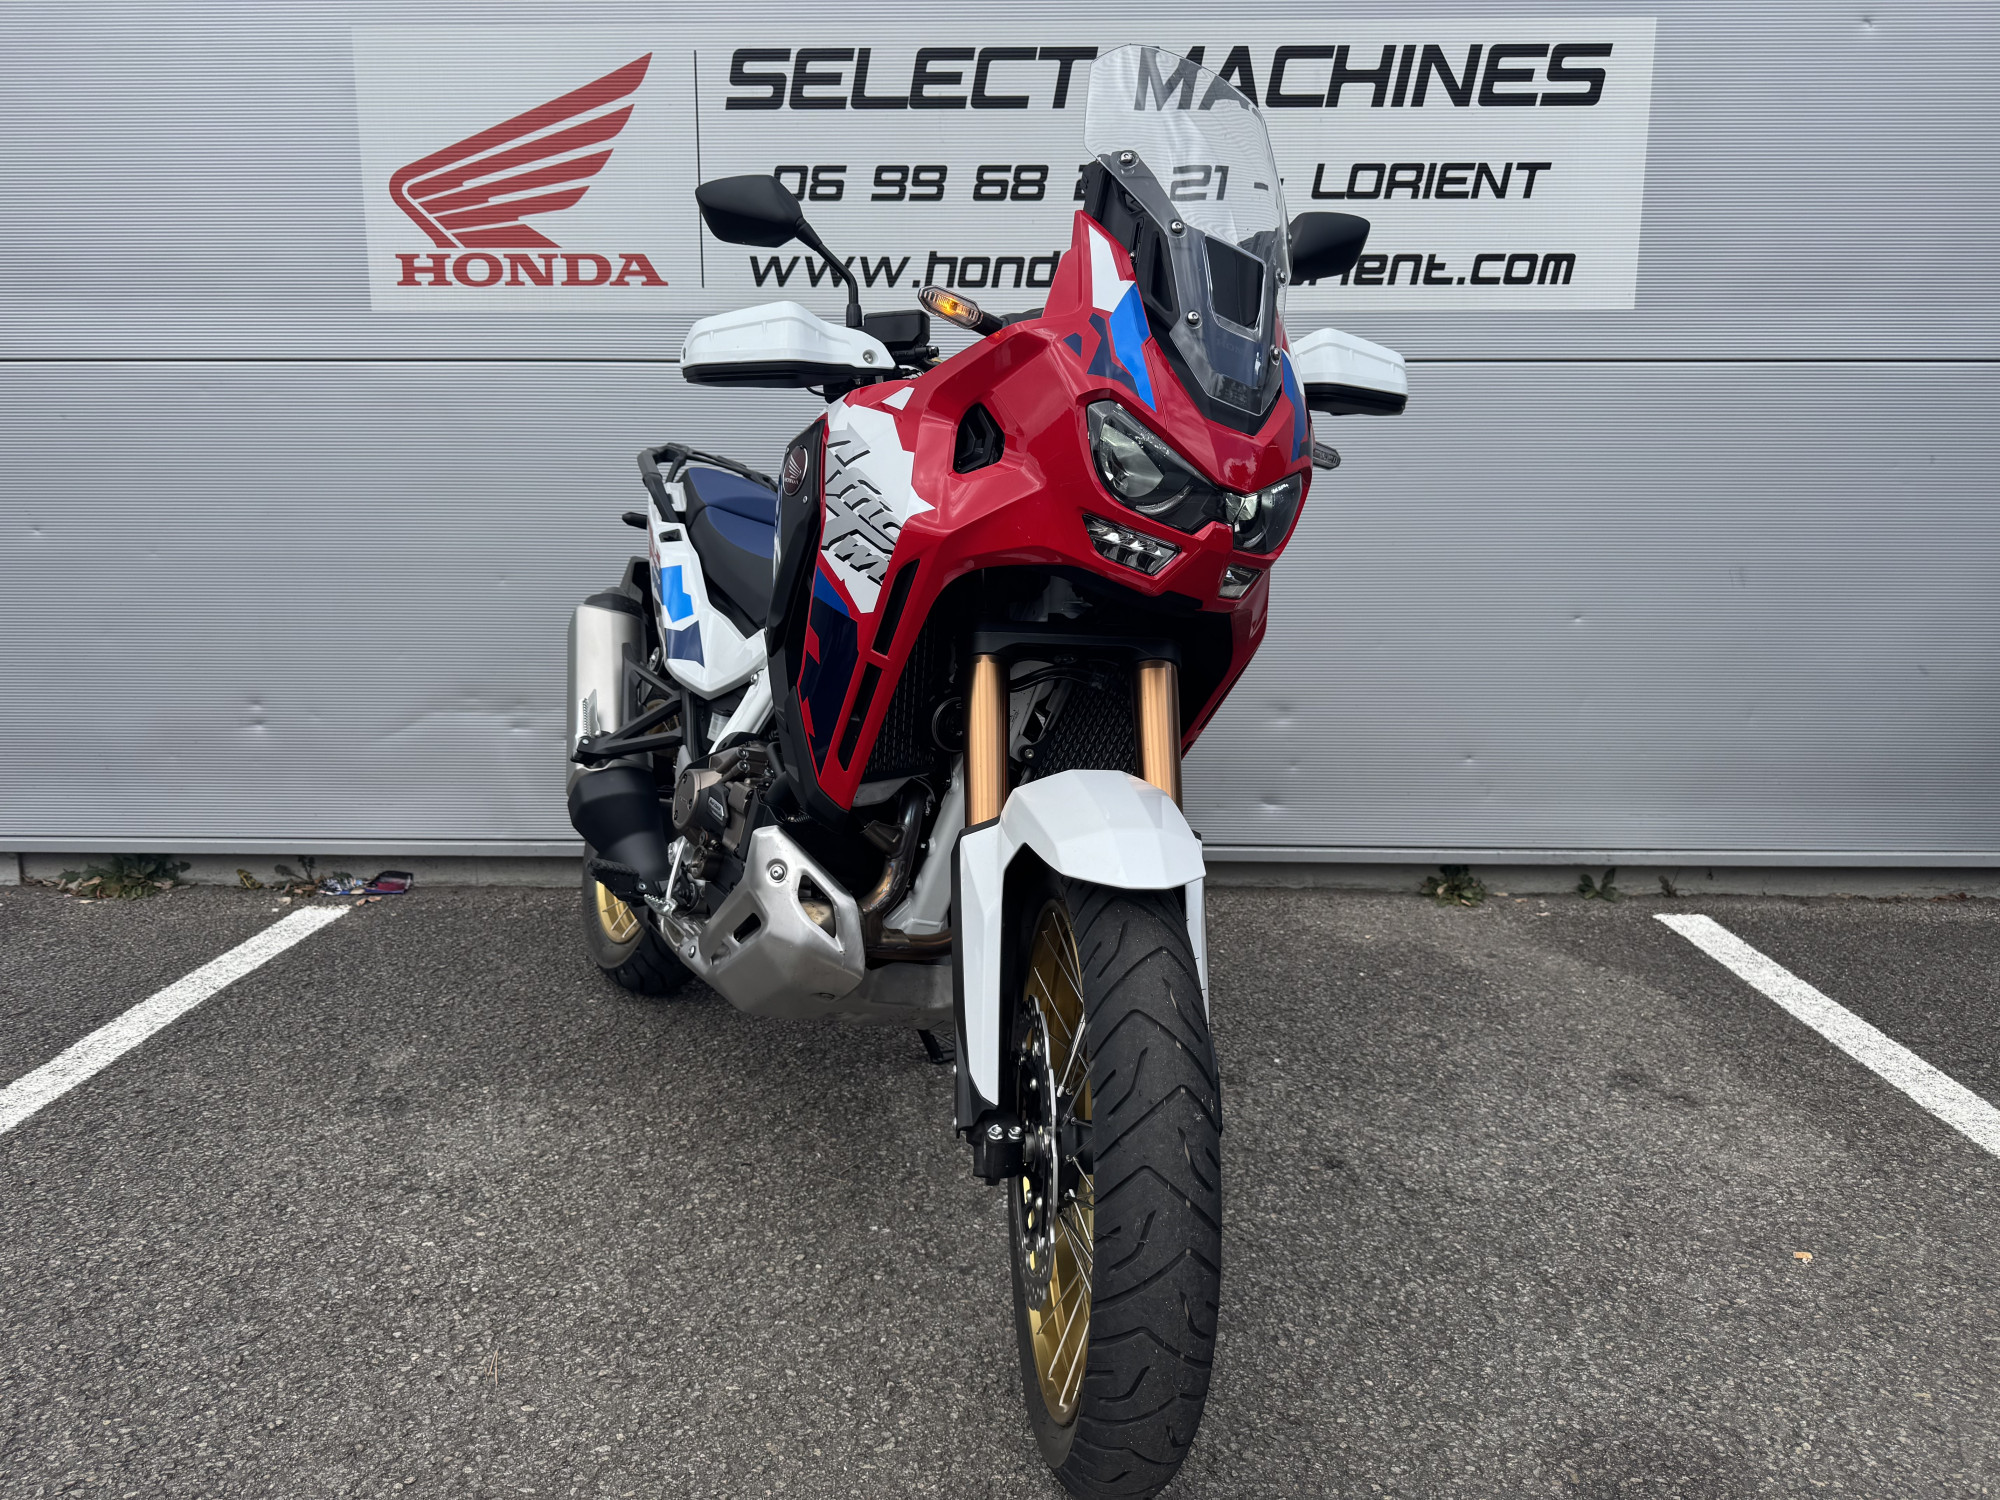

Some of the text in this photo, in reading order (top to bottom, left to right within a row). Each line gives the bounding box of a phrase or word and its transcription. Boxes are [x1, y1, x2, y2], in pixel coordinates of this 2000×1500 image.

[725, 43, 1613, 111] SELECT MACHINES
[773, 165, 847, 201] 06
[871, 165, 948, 201] 99
[972, 164, 1049, 201] 68
[1169, 164, 1229, 201] 21
[1311, 162, 1552, 199] LORIENT
[395, 252, 668, 287] HONDA
